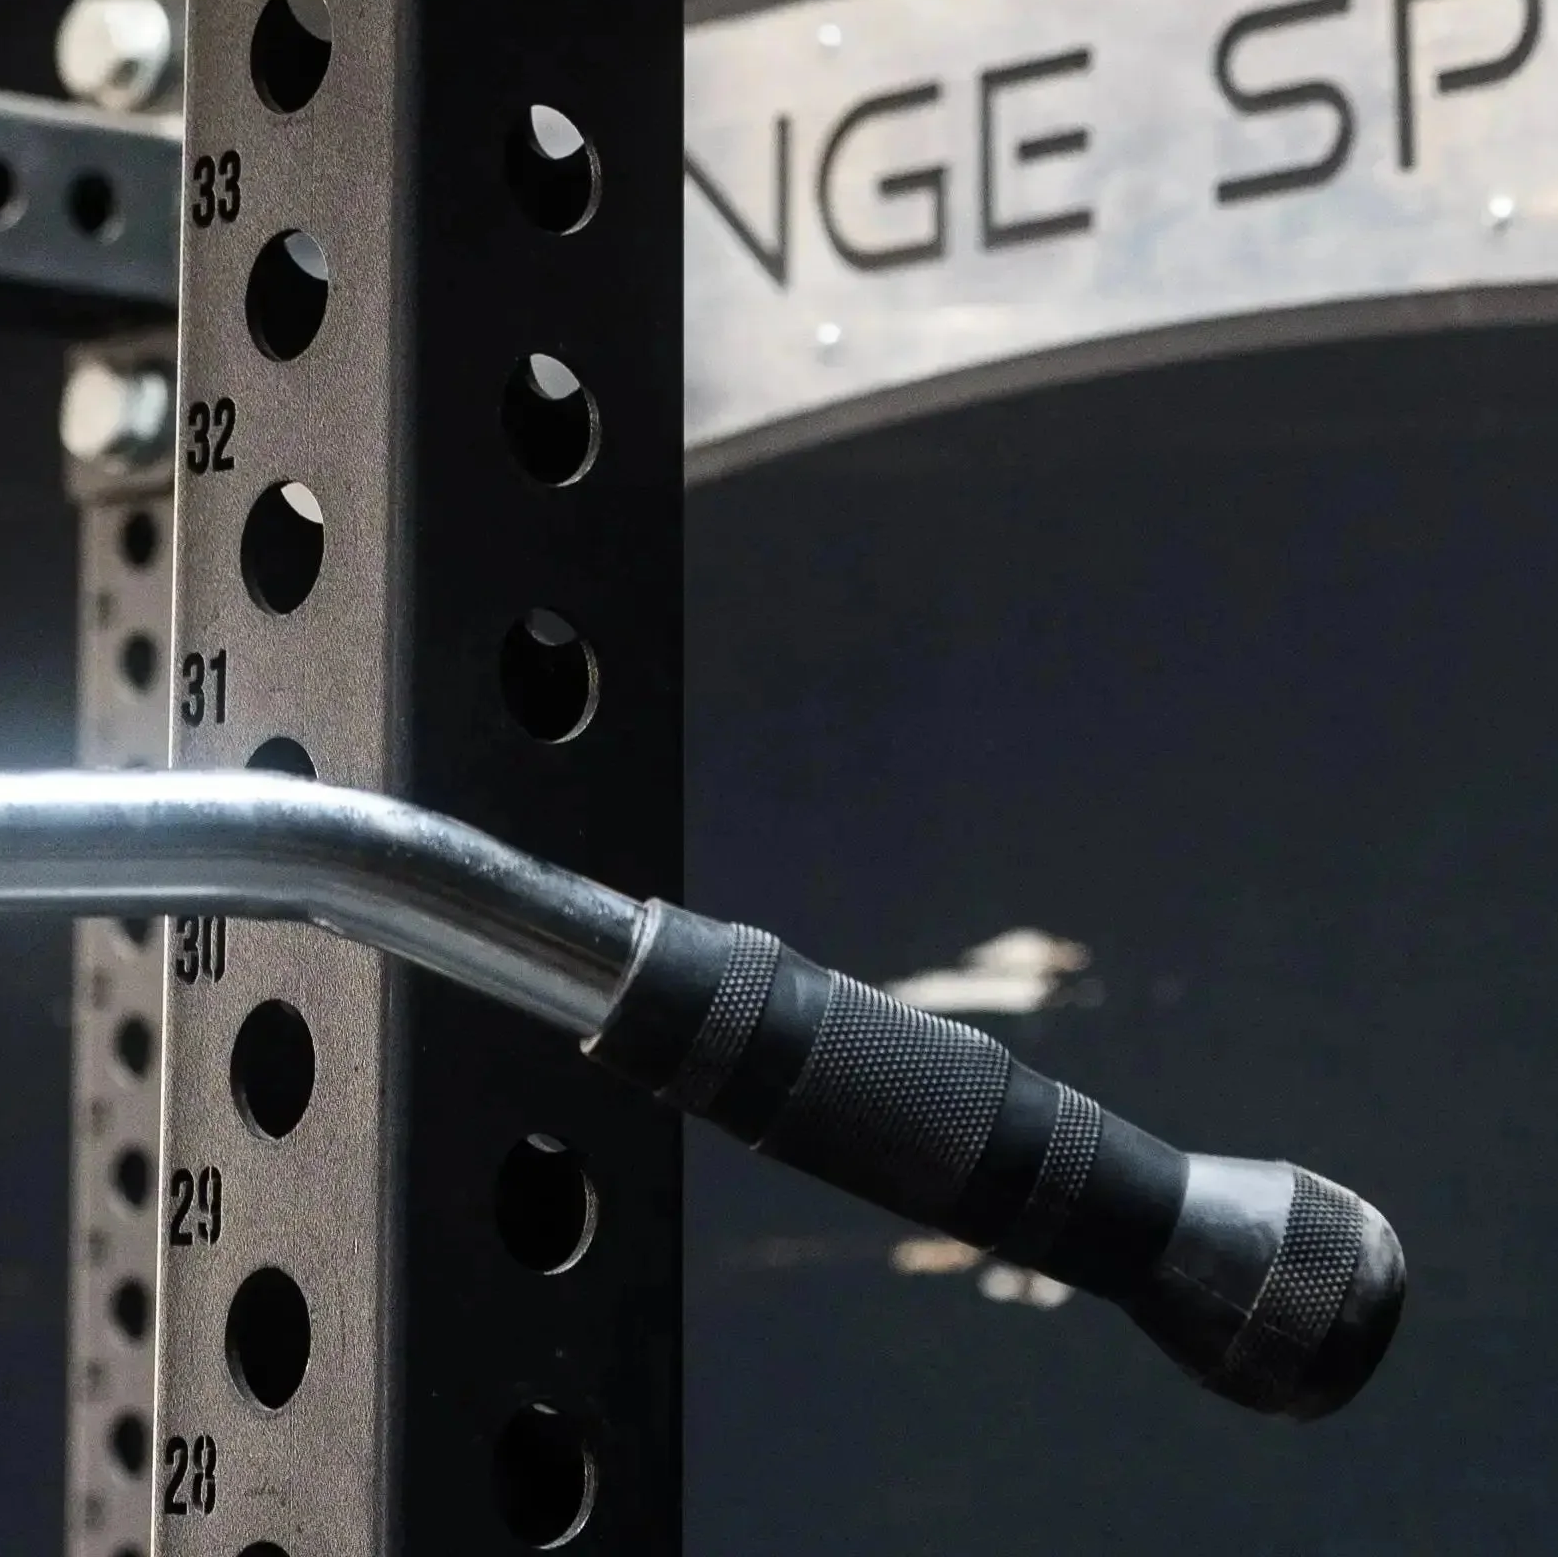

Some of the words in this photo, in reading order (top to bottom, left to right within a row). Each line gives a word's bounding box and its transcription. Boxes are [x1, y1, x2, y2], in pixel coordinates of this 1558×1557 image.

[192, 150, 241, 227] 33
[186, 397, 236, 475] 32
[180, 649, 227, 726] 31
[176, 915, 226, 984] 30
[169, 1167, 222, 1246] 29
[163, 1435, 217, 1515] 28
